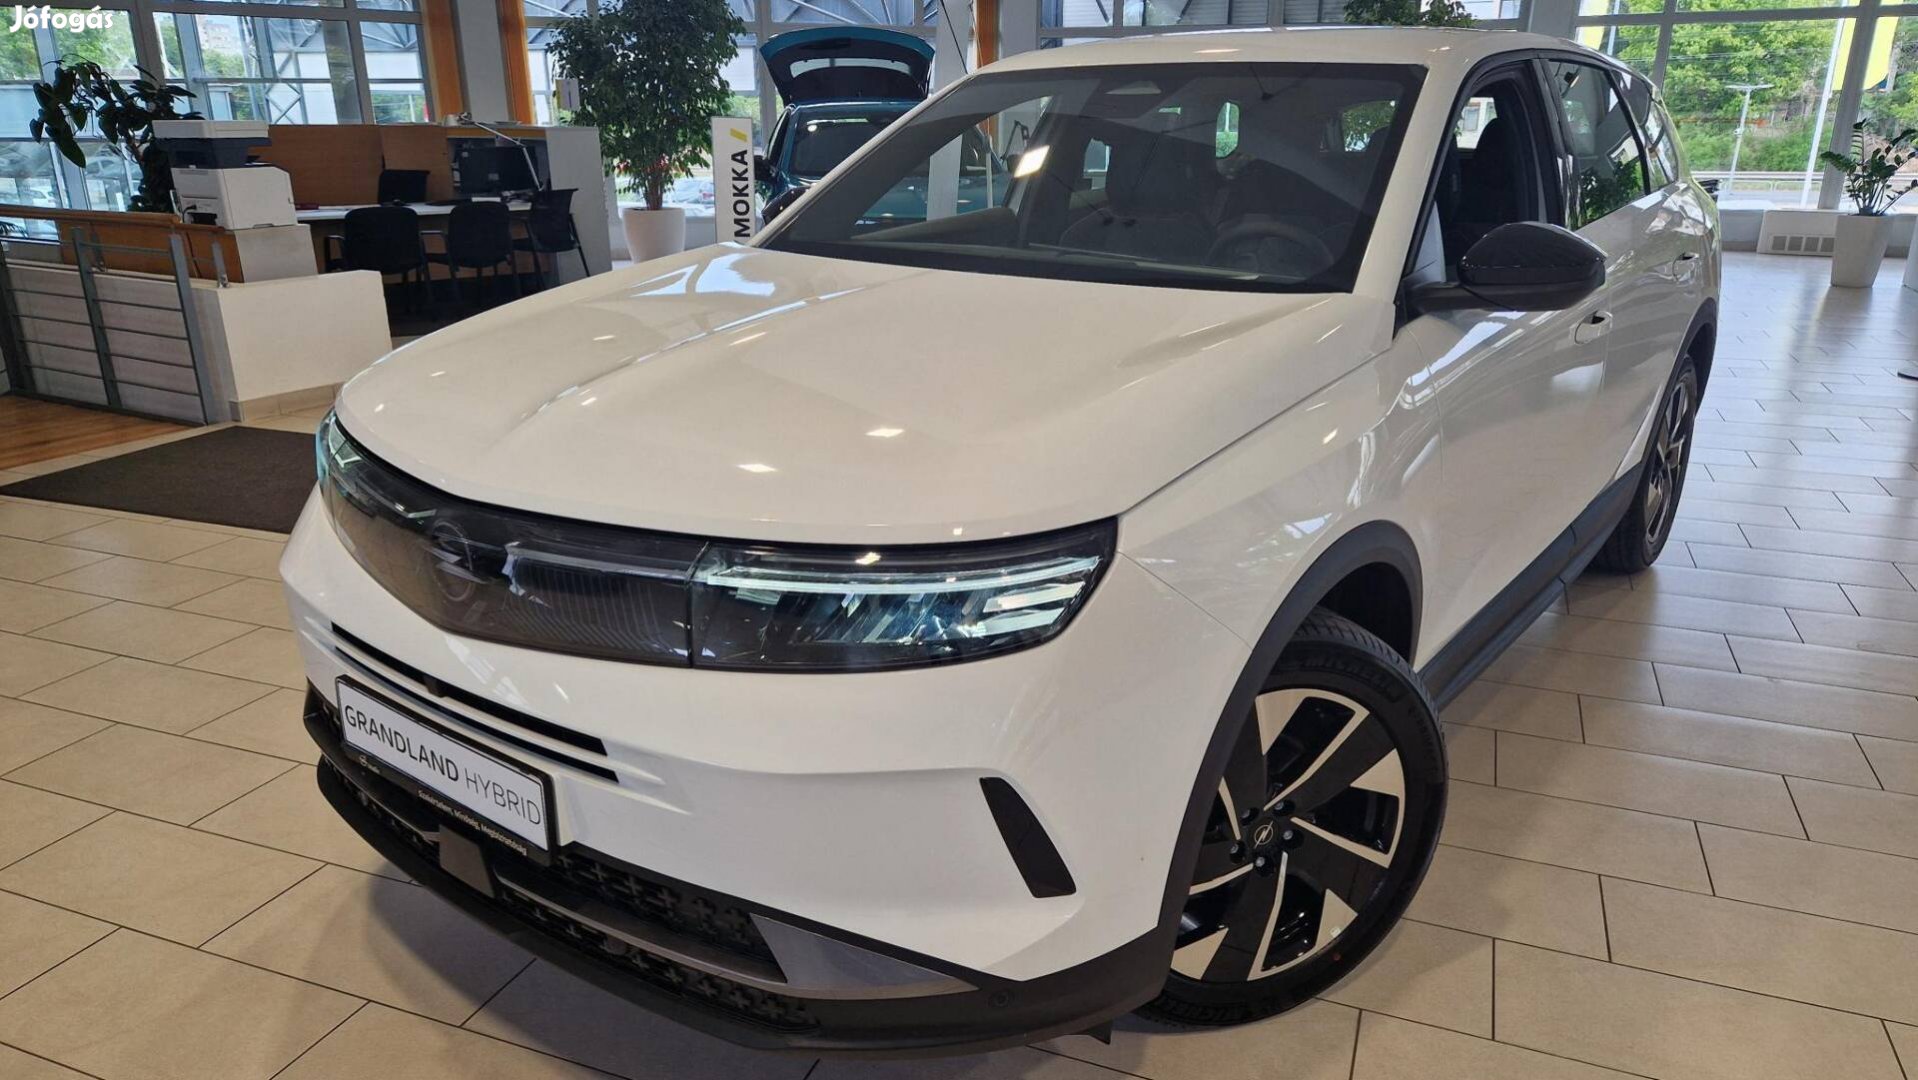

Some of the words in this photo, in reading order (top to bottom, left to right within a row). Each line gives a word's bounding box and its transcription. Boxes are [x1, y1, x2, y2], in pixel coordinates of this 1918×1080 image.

[731, 149, 751, 238] MOKKA
[344, 704, 460, 782] GRANDLAND
[464, 767, 542, 825] HYBRID
